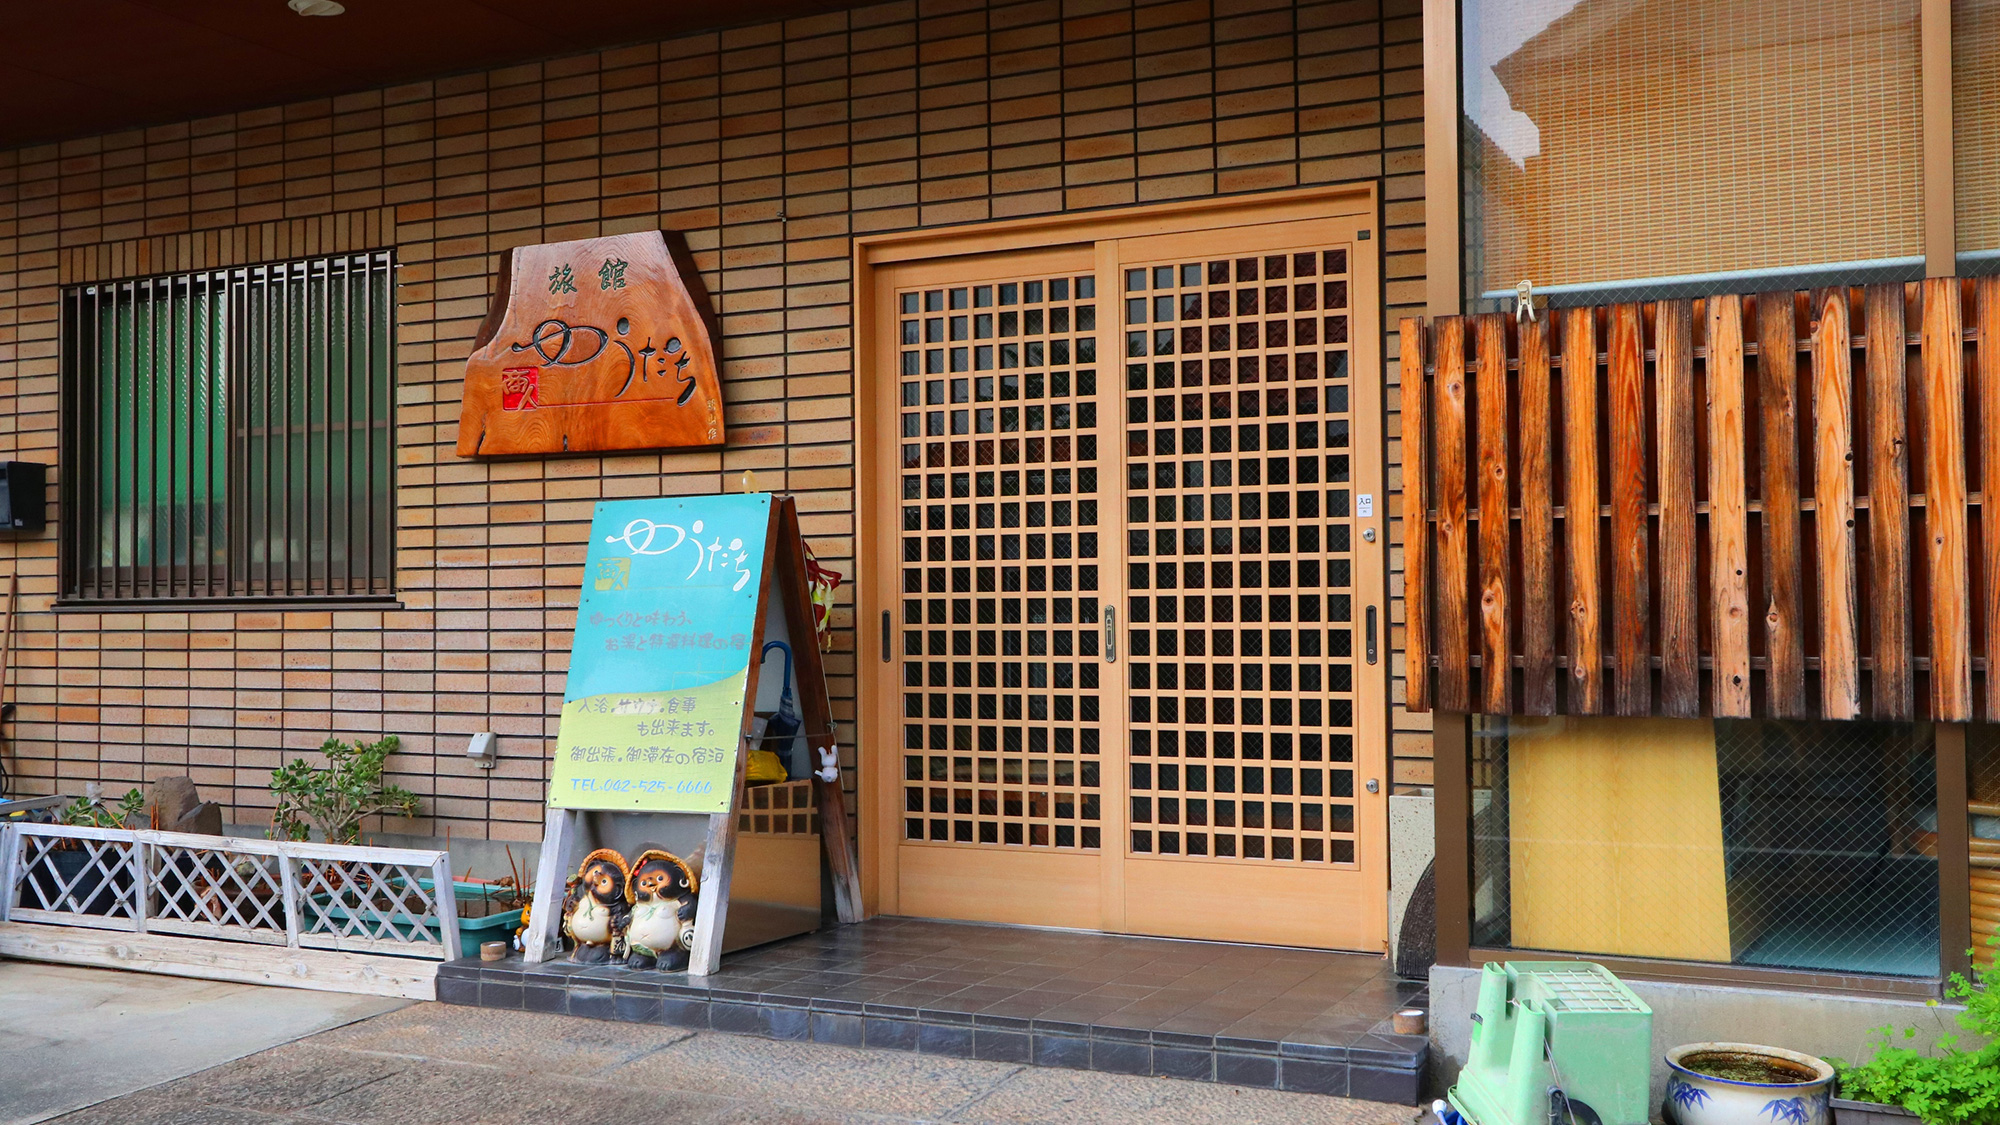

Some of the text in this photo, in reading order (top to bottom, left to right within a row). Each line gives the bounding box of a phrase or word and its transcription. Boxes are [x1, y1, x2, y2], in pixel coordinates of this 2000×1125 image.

[549, 258, 628, 294] 旅館
[1358, 497, 1371, 505] 入口
[637, 719, 715, 737] も出来ます。
